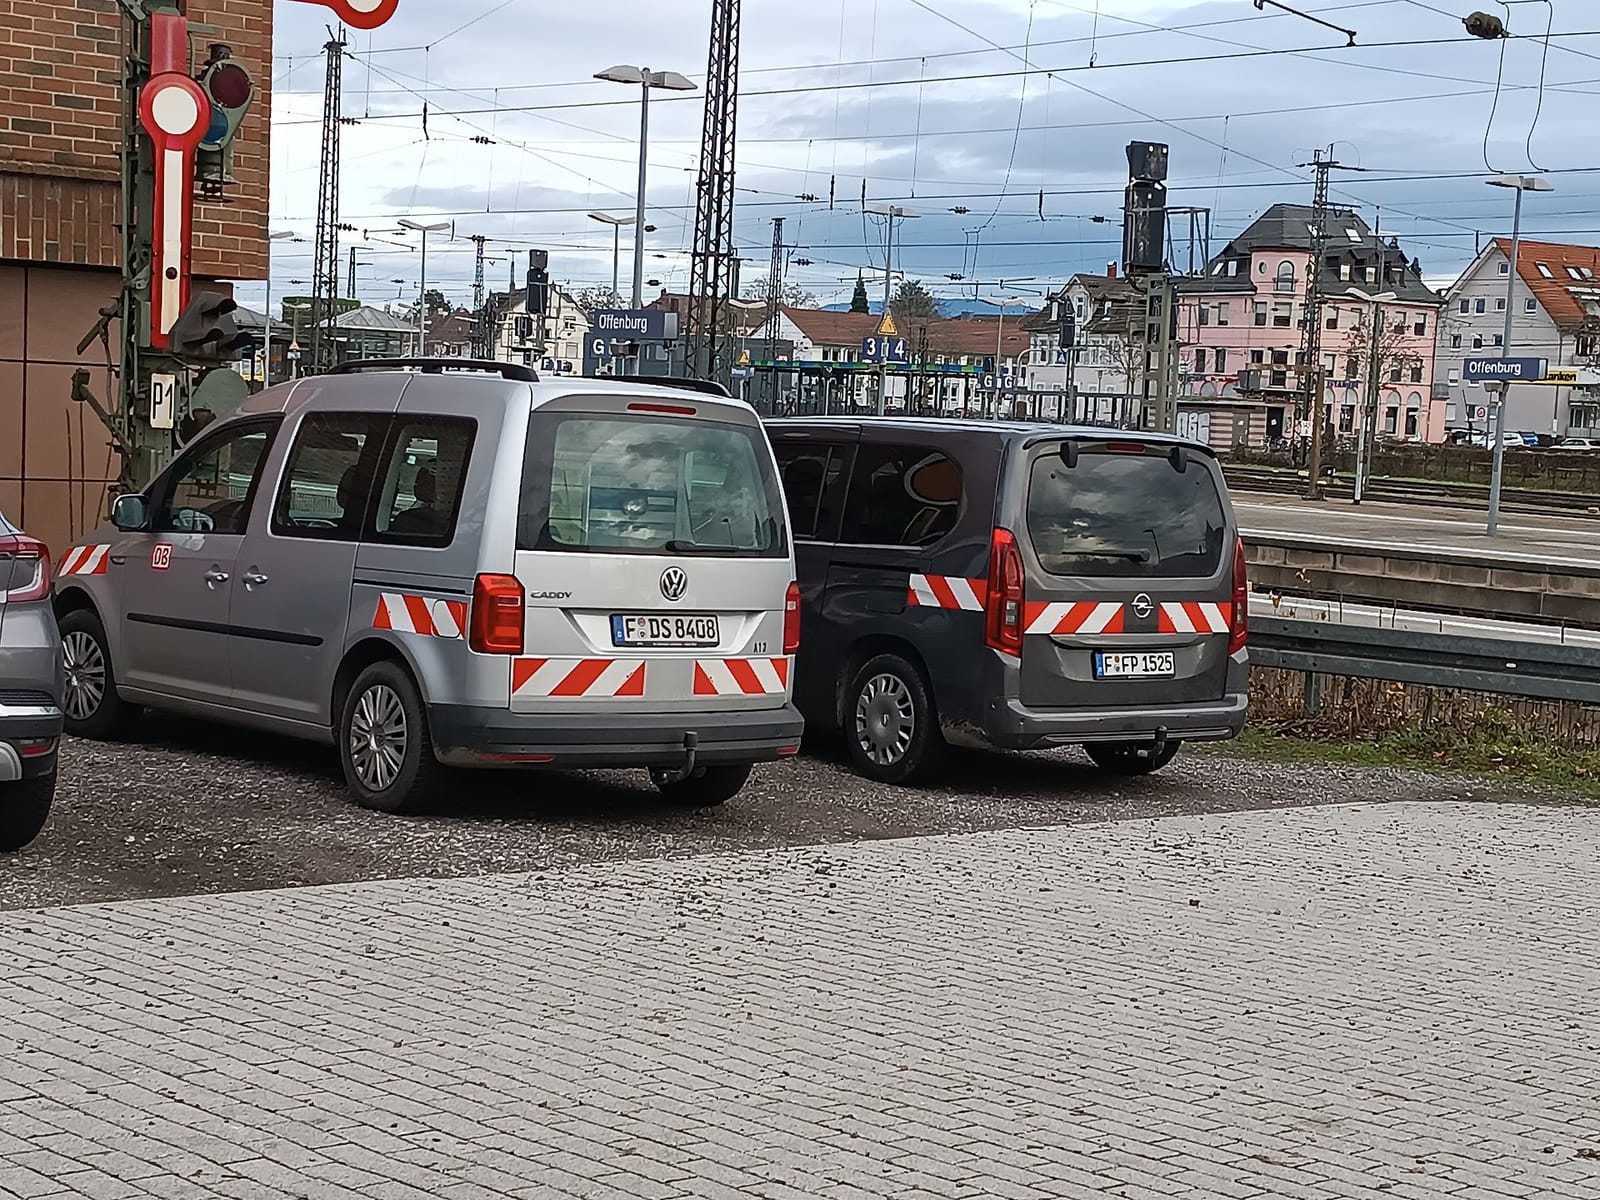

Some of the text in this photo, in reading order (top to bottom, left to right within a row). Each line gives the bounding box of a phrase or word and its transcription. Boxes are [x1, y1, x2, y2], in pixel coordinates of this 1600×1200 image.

[598, 313, 648, 333] Offenburg
[592, 338, 605, 355] G
[866, 337, 905, 360] 3 4
[1469, 361, 1522, 376] Offenburg
[1547, 371, 1577, 382] anken
[983, 375, 1013, 389] G G
[152, 381, 173, 420] P1
[153, 546, 171, 567] DB
[530, 591, 573, 600] CADDY
[625, 617, 637, 639] F
[647, 617, 672, 640] DS
[675, 617, 716, 640] 8408
[1104, 655, 1113, 673] F
[1121, 655, 1139, 673] FP
[1142, 654, 1173, 673] 1525
